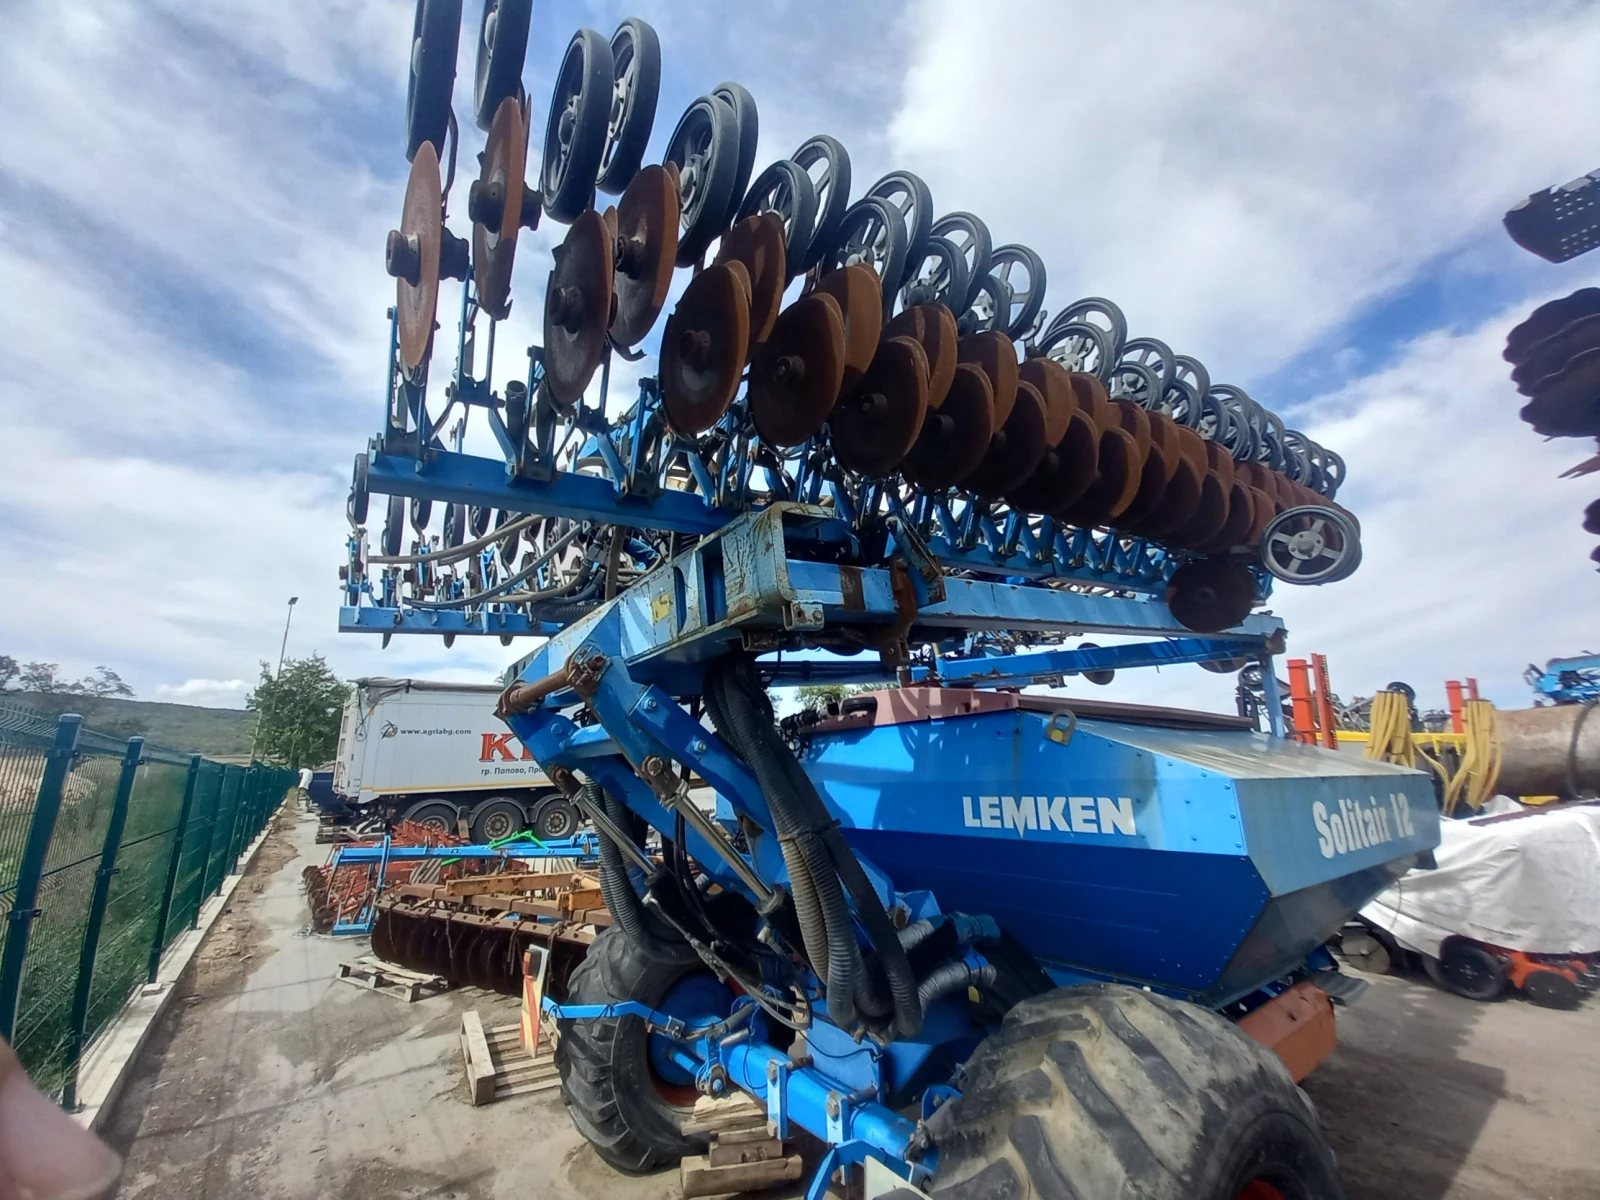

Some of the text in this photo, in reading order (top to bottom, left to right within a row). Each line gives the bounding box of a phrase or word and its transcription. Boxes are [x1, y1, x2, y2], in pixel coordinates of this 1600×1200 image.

[400, 728, 472, 736] www.agriabg.com
[481, 769, 492, 777] гр.
[494, 767, 527, 775] Попово,
[962, 796, 1137, 839] LEMKEN
[1312, 792, 1415, 859] Solitair 12
